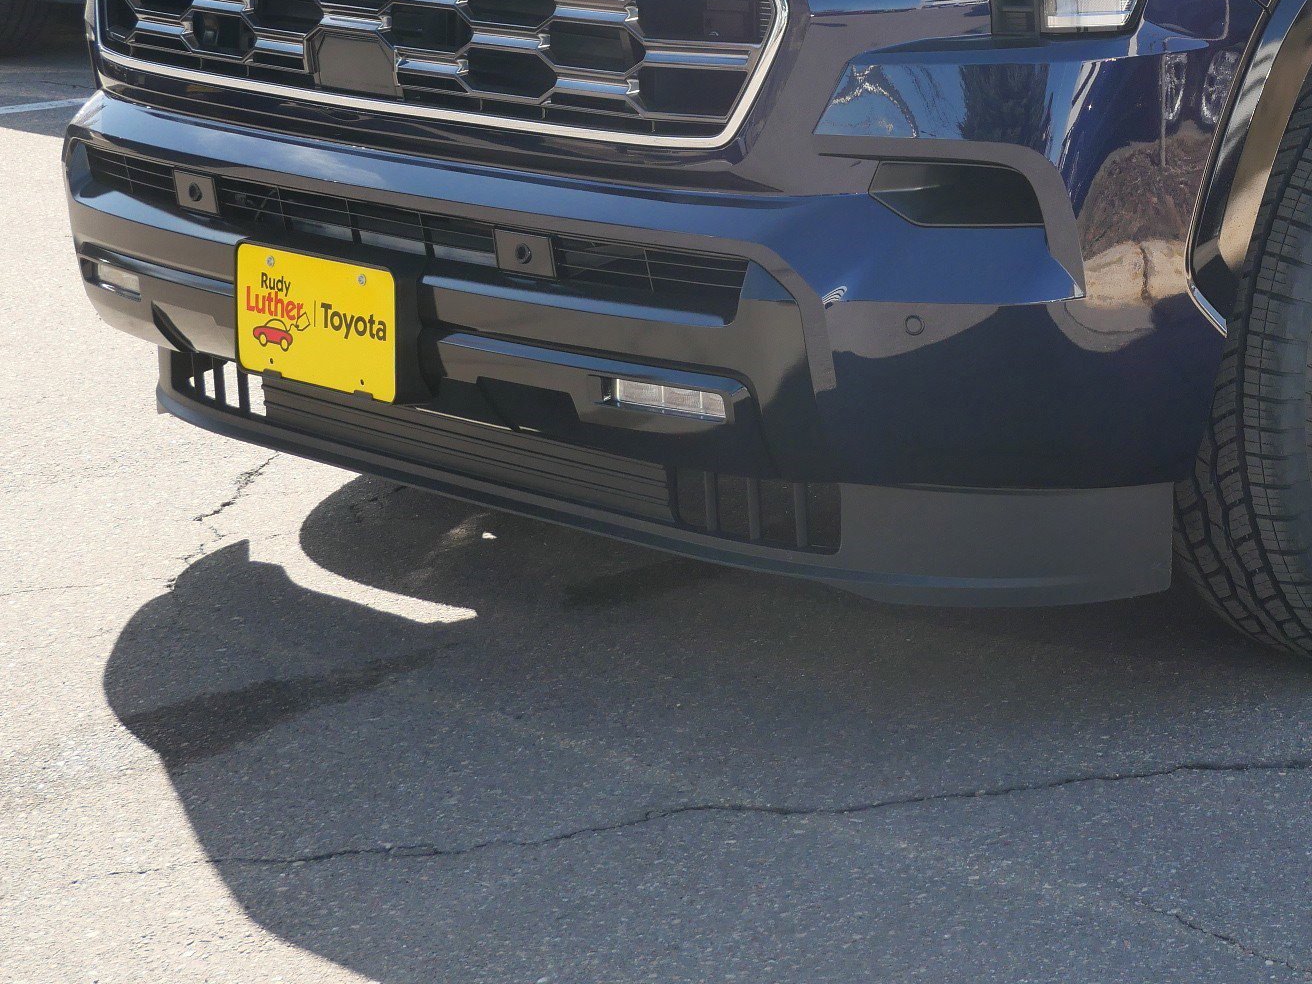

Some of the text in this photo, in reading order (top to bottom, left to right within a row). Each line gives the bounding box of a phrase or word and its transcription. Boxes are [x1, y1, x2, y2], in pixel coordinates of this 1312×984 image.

[260, 272, 291, 297] Rudy
[246, 286, 387, 342] Luther Toyota
